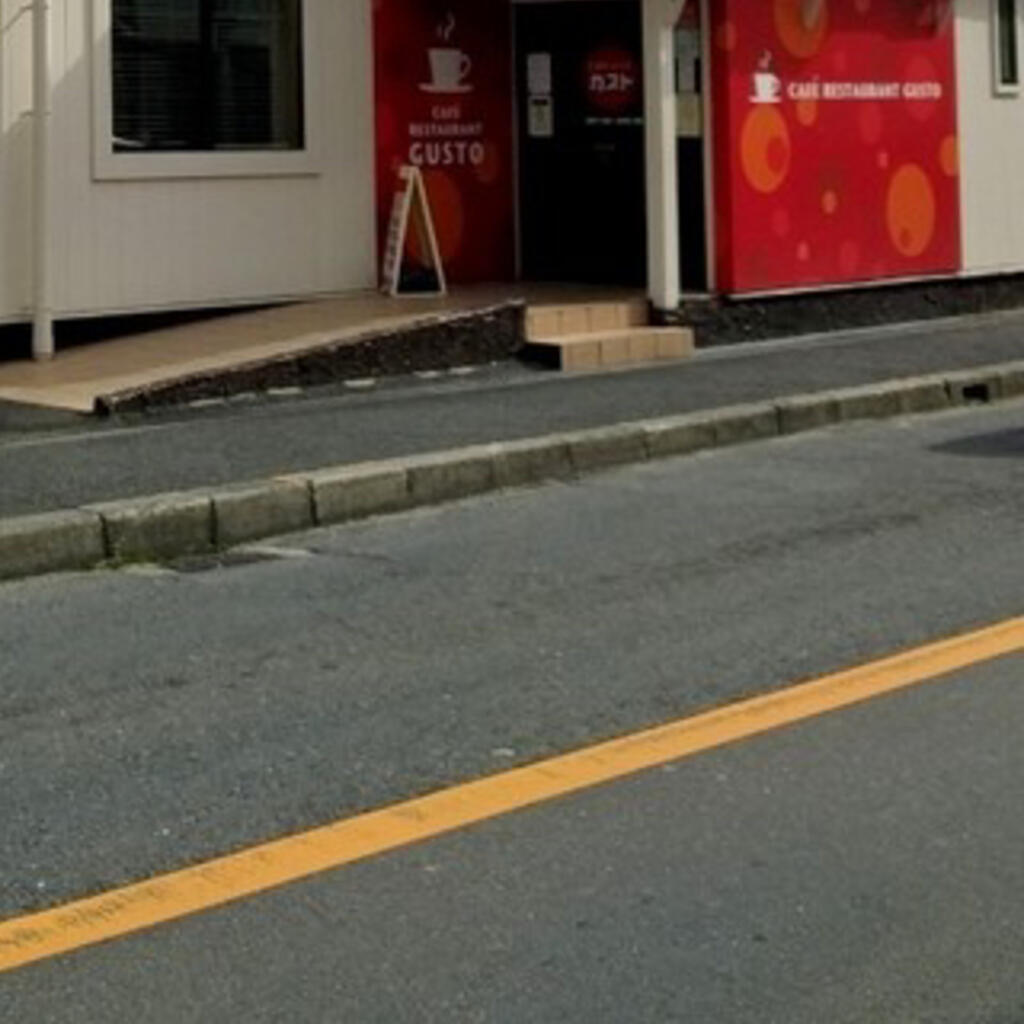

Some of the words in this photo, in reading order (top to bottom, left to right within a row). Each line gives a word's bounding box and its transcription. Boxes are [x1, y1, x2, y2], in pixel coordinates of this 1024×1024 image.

[588, 72, 634, 93] ガスト
[902, 82, 943, 100] GUSTO
[408, 140, 485, 166] GUSTO
